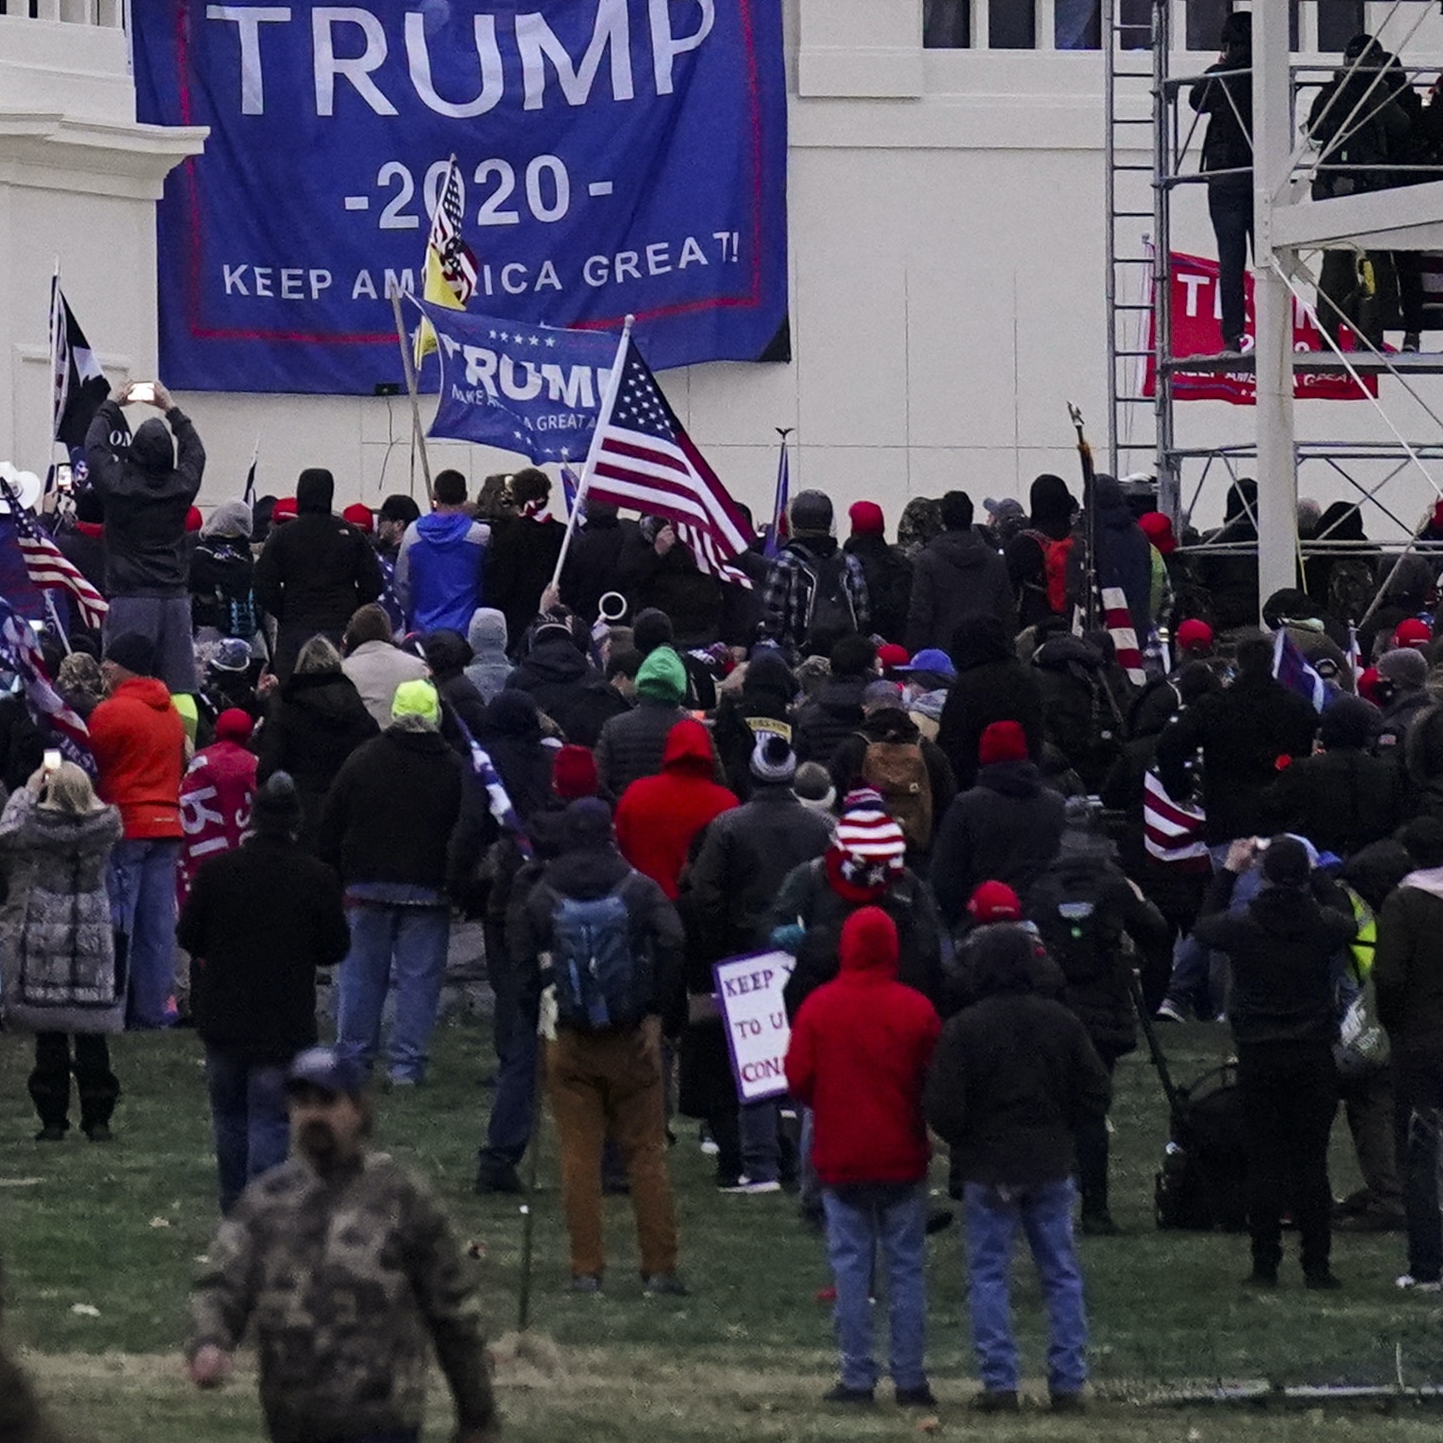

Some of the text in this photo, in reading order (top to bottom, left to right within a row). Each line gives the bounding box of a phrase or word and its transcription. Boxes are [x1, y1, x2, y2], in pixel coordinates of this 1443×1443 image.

[223, 230, 741, 300] KEEP AMICA GREAT!
[536, 413, 588, 432] GREAT
[724, 969, 774, 997] KEEP
[734, 1018, 762, 1040] TO
